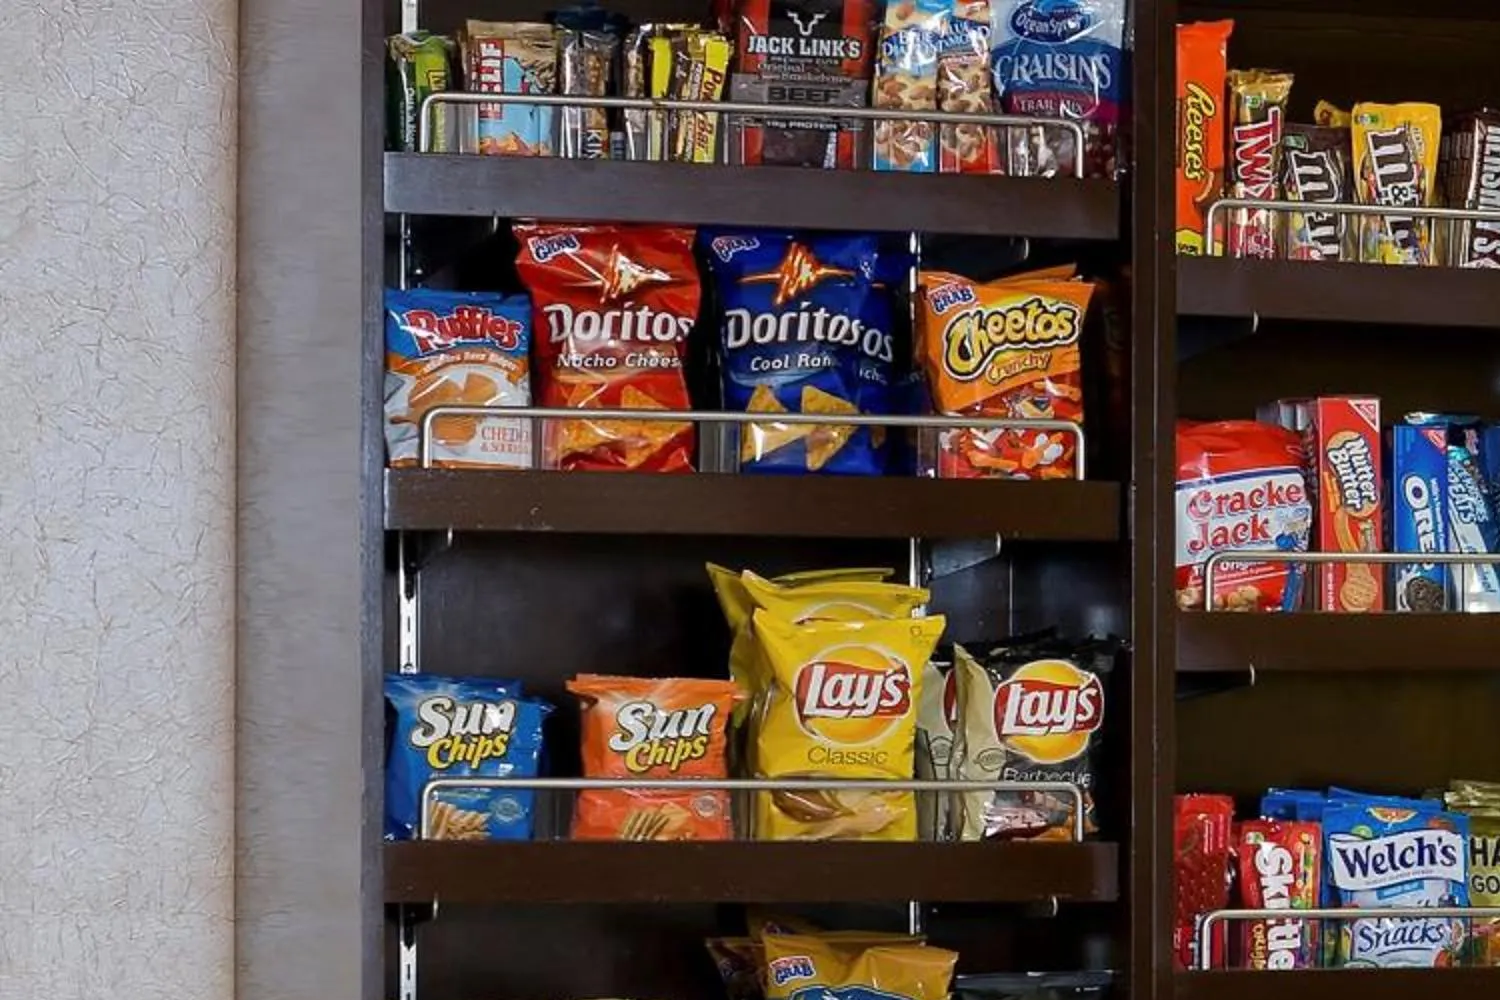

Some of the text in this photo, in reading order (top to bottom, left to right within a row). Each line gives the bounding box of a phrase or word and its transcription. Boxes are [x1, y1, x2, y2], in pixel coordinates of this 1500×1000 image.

[748, 35, 861, 58] JACK LINK'S
[994, 53, 1112, 89] CRAISINS
[1185, 82, 1216, 180] Reese's
[405, 305, 524, 356] Ruffles
[544, 303, 694, 343] Doritos
[725, 302, 864, 348] Doritos
[945, 297, 1077, 376] Cheetos
[557, 351, 681, 368] Nacho Chees
[751, 353, 833, 371] Cool Ran
[986, 352, 1051, 384] Crunchy
[1328, 448, 1363, 512] Butter
[1345, 435, 1377, 506] Nutter
[1187, 481, 1302, 522] Cracke
[1187, 515, 1270, 555] Jack
[803, 665, 909, 718] Lay's
[1003, 682, 1098, 737] Lay's
[413, 697, 516, 748] Sun
[610, 704, 716, 751] Sun
[429, 734, 508, 769] Chips
[624, 738, 708, 773] Chips
[807, 746, 889, 766] Classic
[1337, 837, 1457, 878] Welch's
[1358, 922, 1446, 952] Snacks
